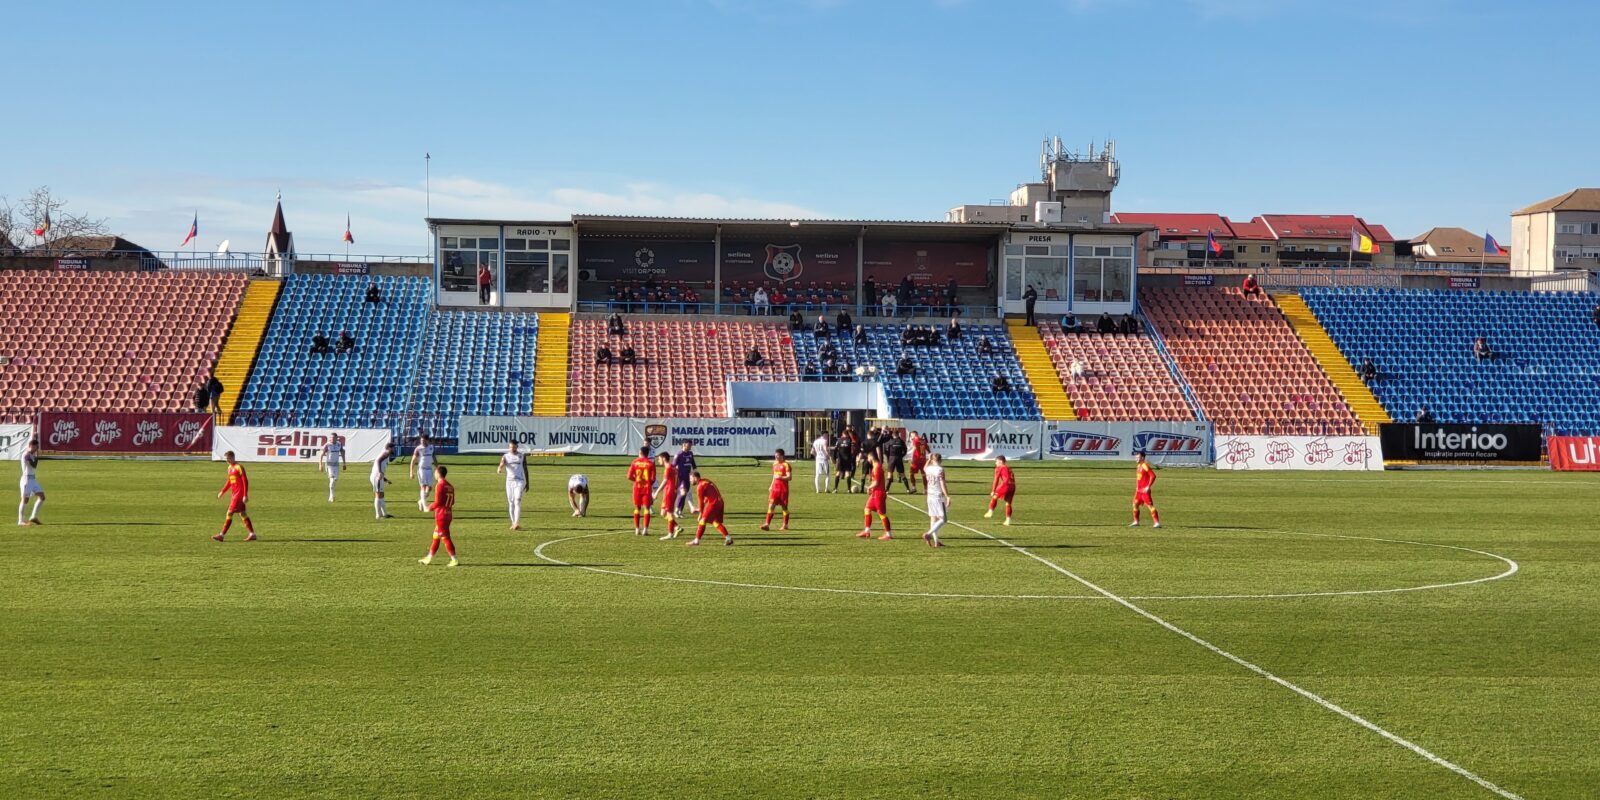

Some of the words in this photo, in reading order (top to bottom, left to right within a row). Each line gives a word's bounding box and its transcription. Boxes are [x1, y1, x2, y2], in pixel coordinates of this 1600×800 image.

[54, 419, 75, 431] Viva
[95, 420, 117, 432] Viva
[137, 420, 160, 432] Viva
[178, 420, 200, 433] Viva
[672, 427, 705, 435] MAREA
[49, 428, 80, 445] Chips
[91, 428, 122, 445] Chips
[132, 428, 164, 446] Chips
[467, 431, 536, 446] MINUNILOR
[548, 432, 617, 446] MINUNILOR
[672, 436, 704, 446] ÎNPE
[706, 438, 730, 447] AICI!
[987, 433, 1034, 445] MARTY
[1414, 426, 1507, 450] Interioo
[1069, 438, 1119, 451] BMV
[1150, 438, 1201, 451] BMV
[1228, 441, 1250, 453] Viva
[1267, 441, 1289, 453] Viva
[1305, 442, 1328, 453] Viva
[1345, 442, 1366, 453] Viva
[1569, 437, 1600, 465] ut
[1226, 448, 1255, 465] Chips
[1265, 448, 1294, 465] Chips
[1304, 449, 1333, 465] Chips
[1343, 449, 1372, 465] Chips
